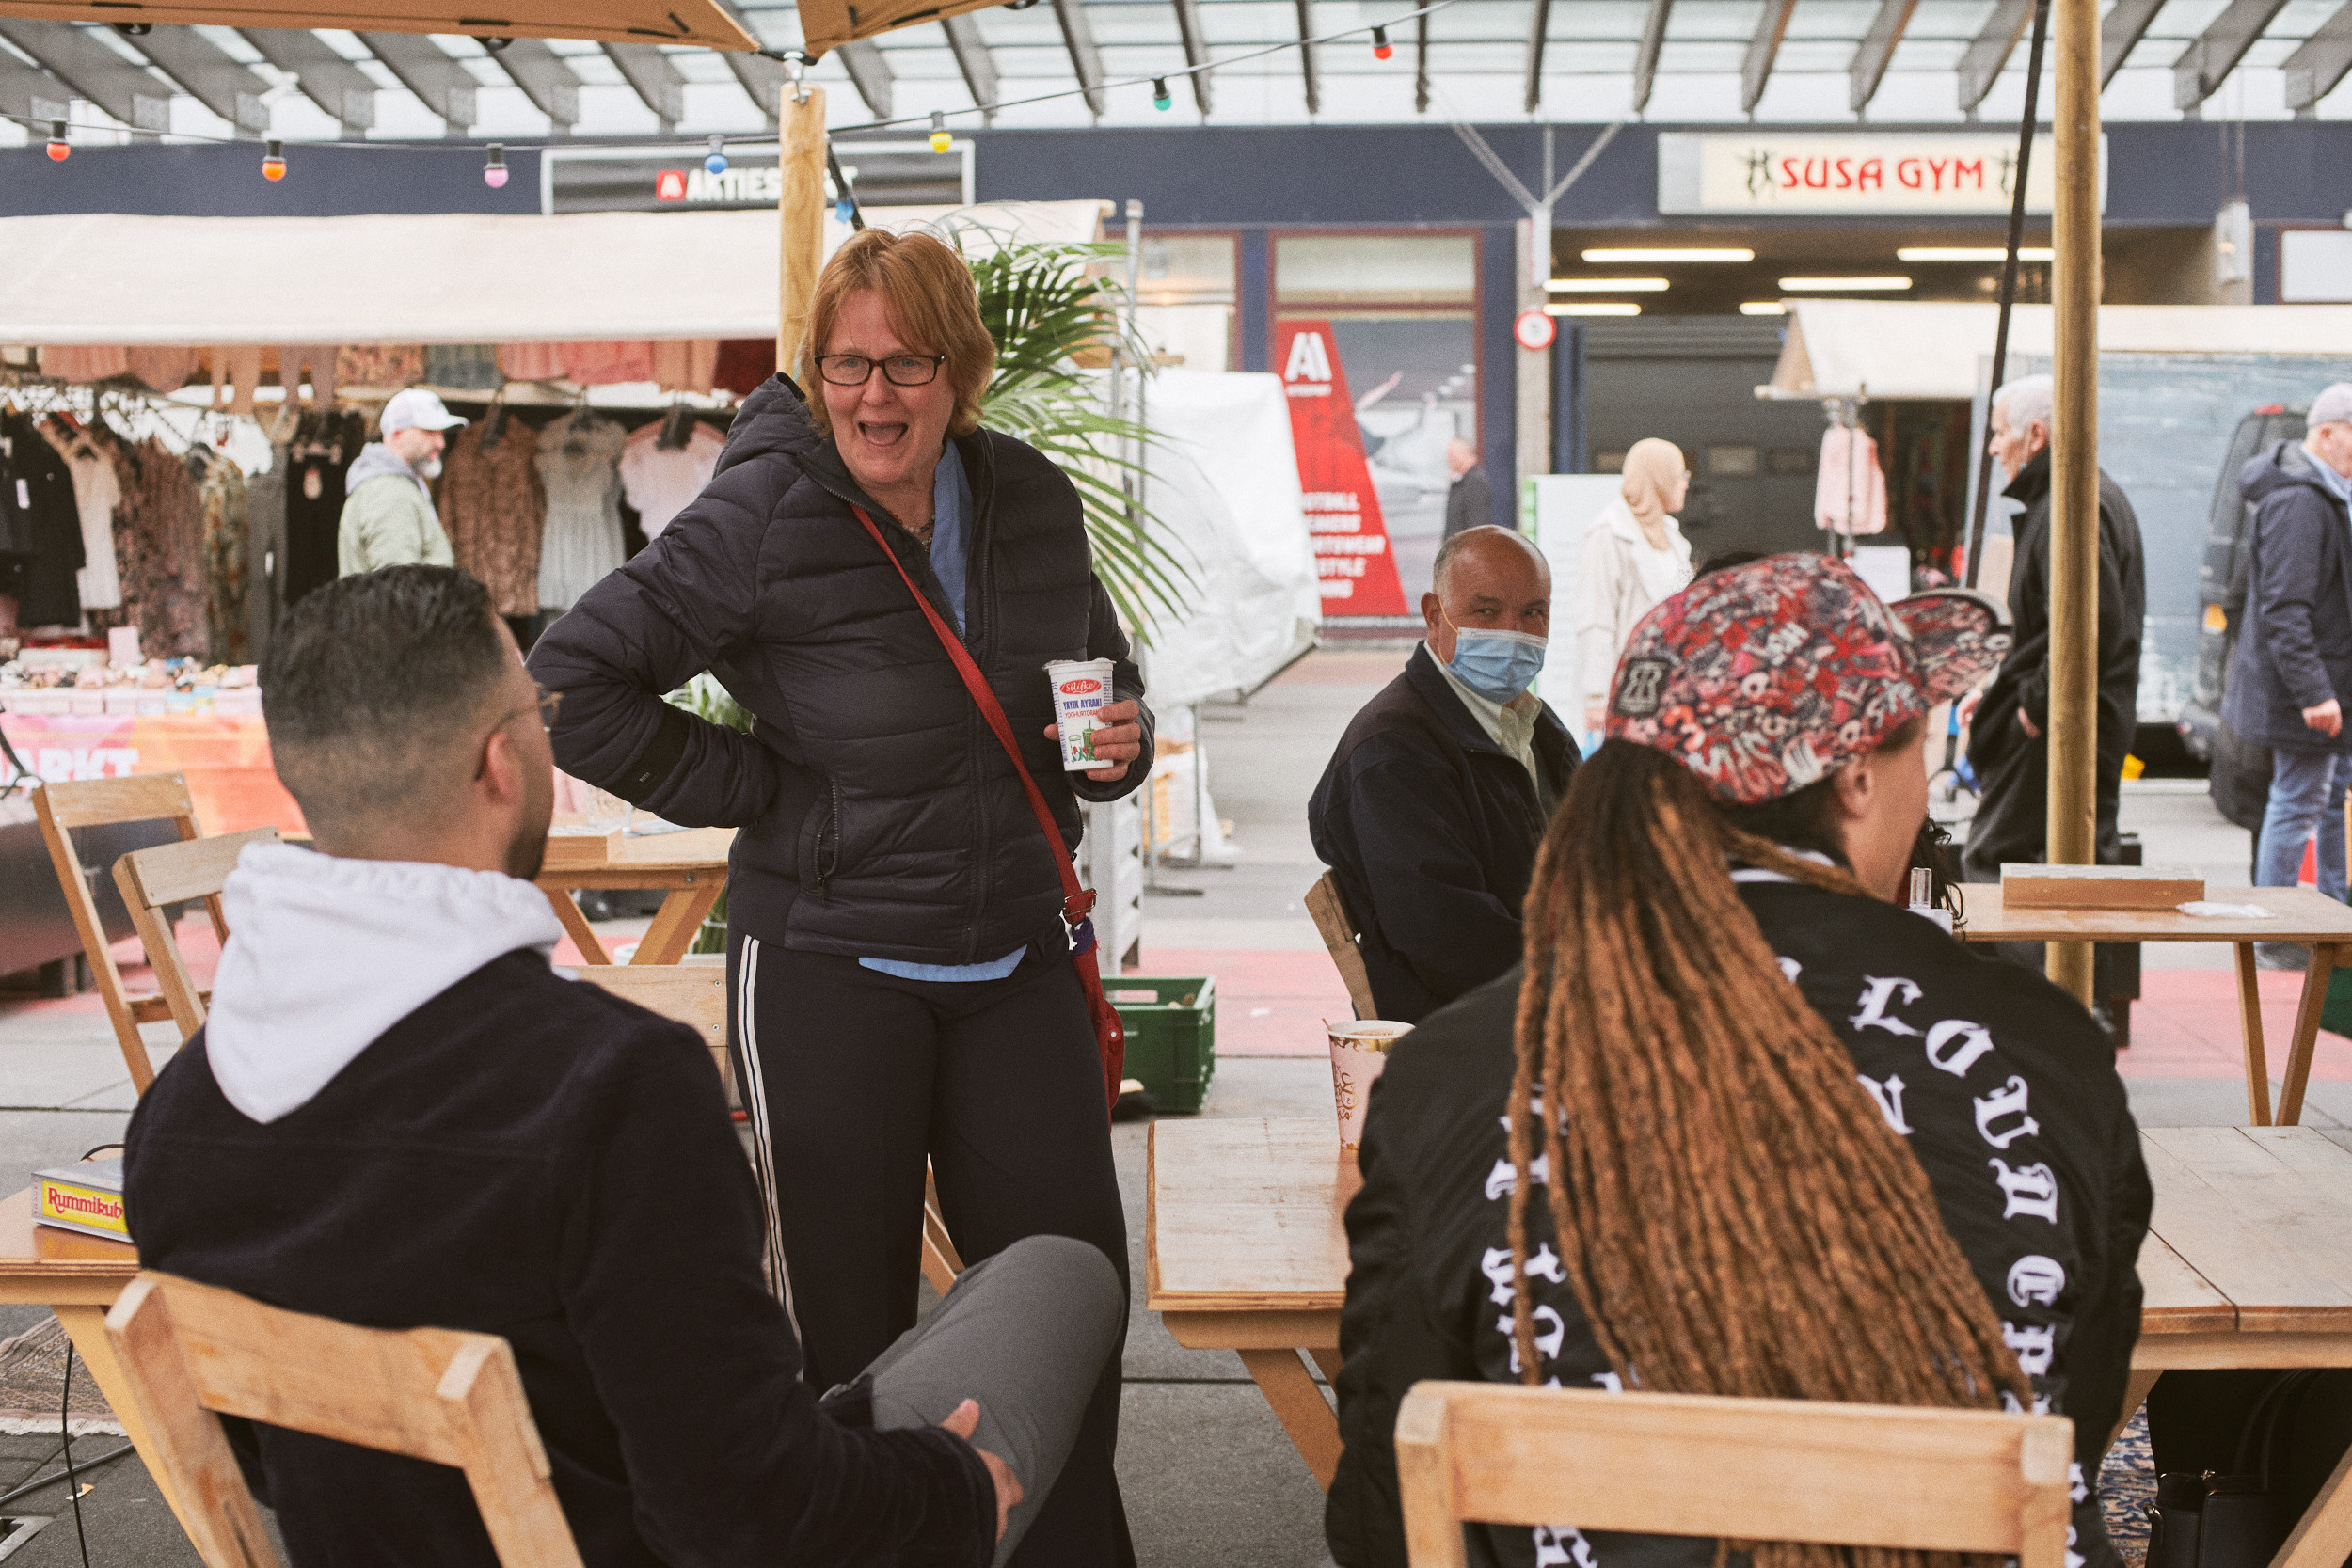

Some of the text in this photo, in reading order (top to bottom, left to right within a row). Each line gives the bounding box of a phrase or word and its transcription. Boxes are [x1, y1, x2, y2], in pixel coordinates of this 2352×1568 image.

[1781, 158, 1984, 193] SUSA GYM
[1065, 680, 1094, 692] Silifke
[48, 1187, 123, 1219] Rummikub
